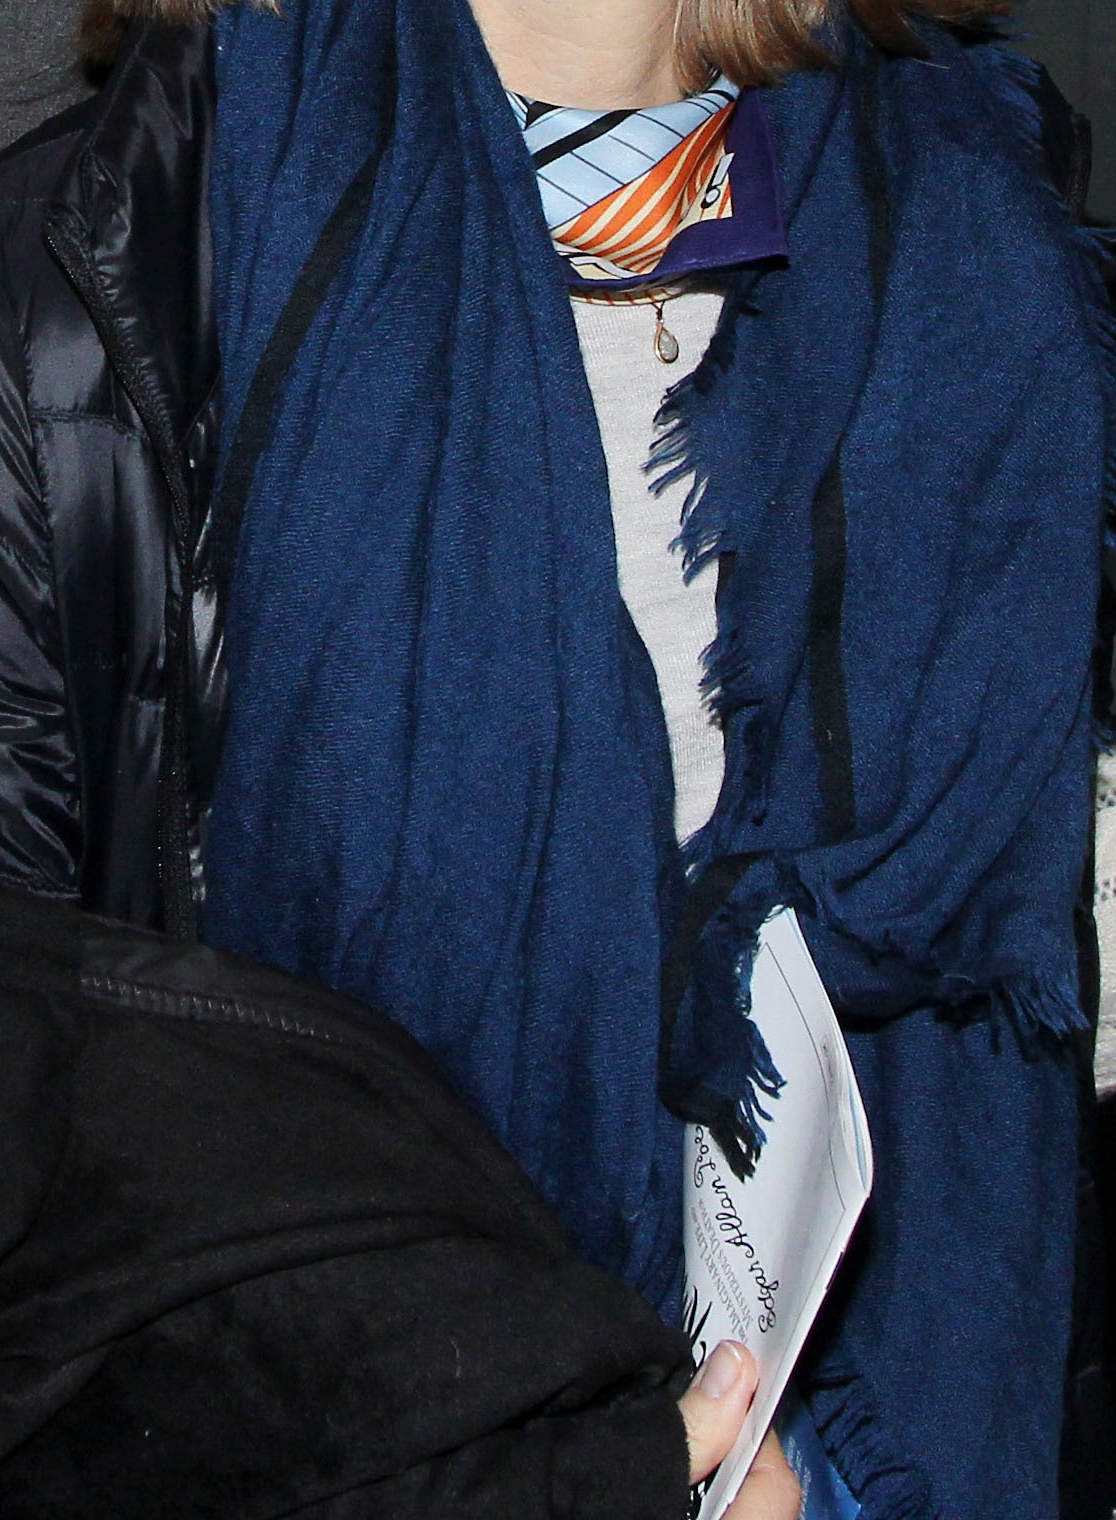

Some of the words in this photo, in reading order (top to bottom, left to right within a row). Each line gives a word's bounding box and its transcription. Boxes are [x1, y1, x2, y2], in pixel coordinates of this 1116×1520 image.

[693, 1125, 717, 1189] Poe
[712, 1175, 755, 1259] Allan
[704, 1253, 745, 1333] IMAGINARY
[716, 1247, 754, 1331] MYSTERIOUS
[748, 1260, 780, 1333] Edgar
